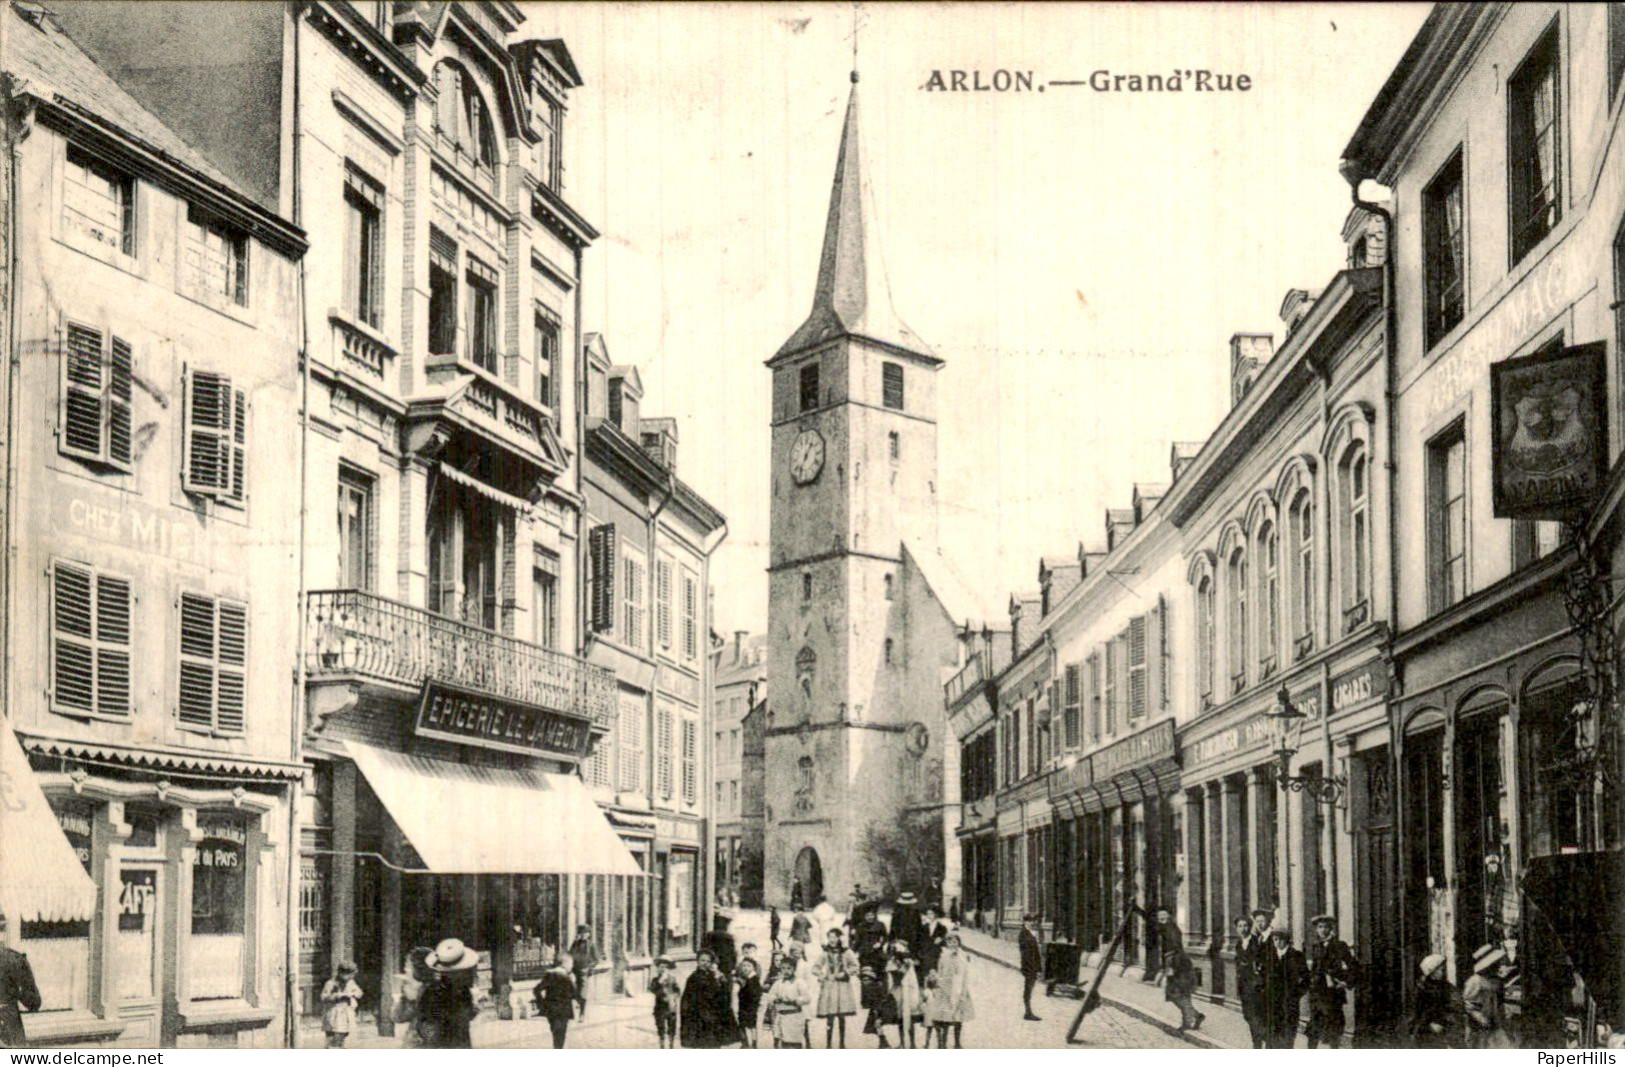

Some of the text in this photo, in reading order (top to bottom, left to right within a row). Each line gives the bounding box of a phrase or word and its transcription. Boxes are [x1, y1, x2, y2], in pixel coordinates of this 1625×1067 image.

[69, 499, 121, 531] CHEZ
[428, 695, 582, 750] EPICERIE LE JAMBON
[215, 849, 238, 867] PAYS
